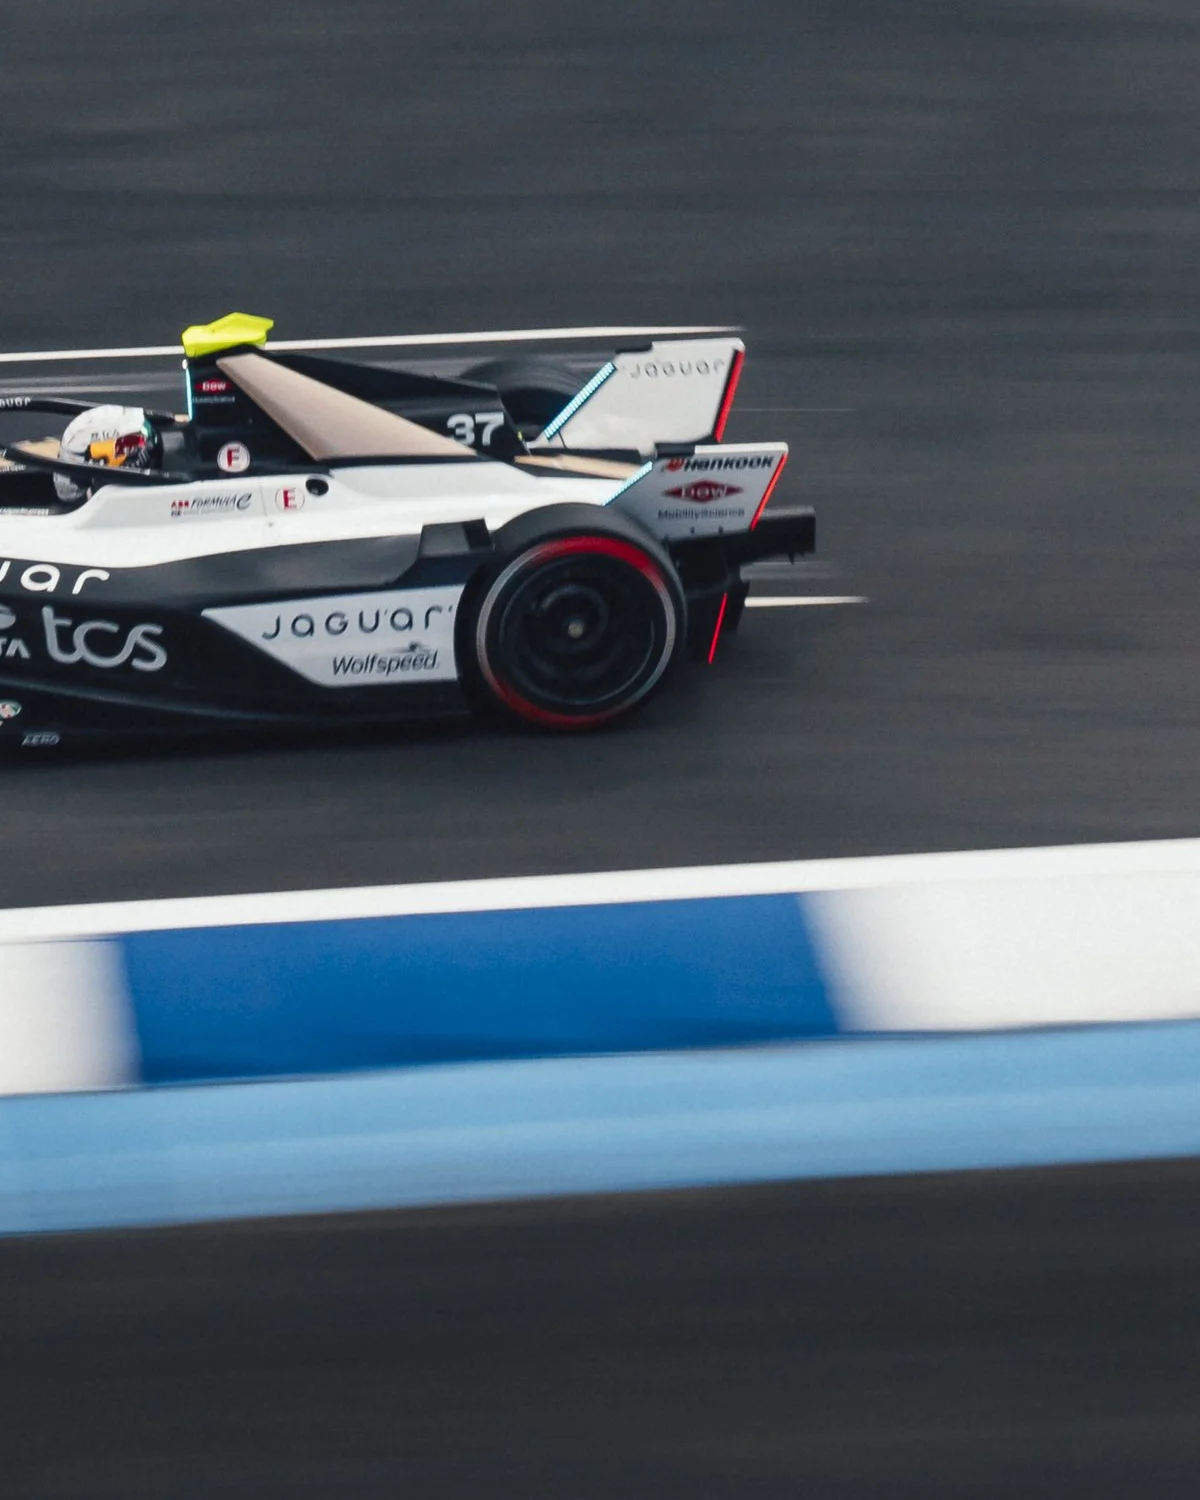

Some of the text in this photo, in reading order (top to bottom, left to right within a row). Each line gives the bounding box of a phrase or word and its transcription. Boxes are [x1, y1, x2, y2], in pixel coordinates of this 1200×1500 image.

[446, 412, 505, 446] 37
[683, 456, 775, 473] Hankook
[41, 605, 168, 672] tcs
[333, 650, 438, 677] Wolfspeed
